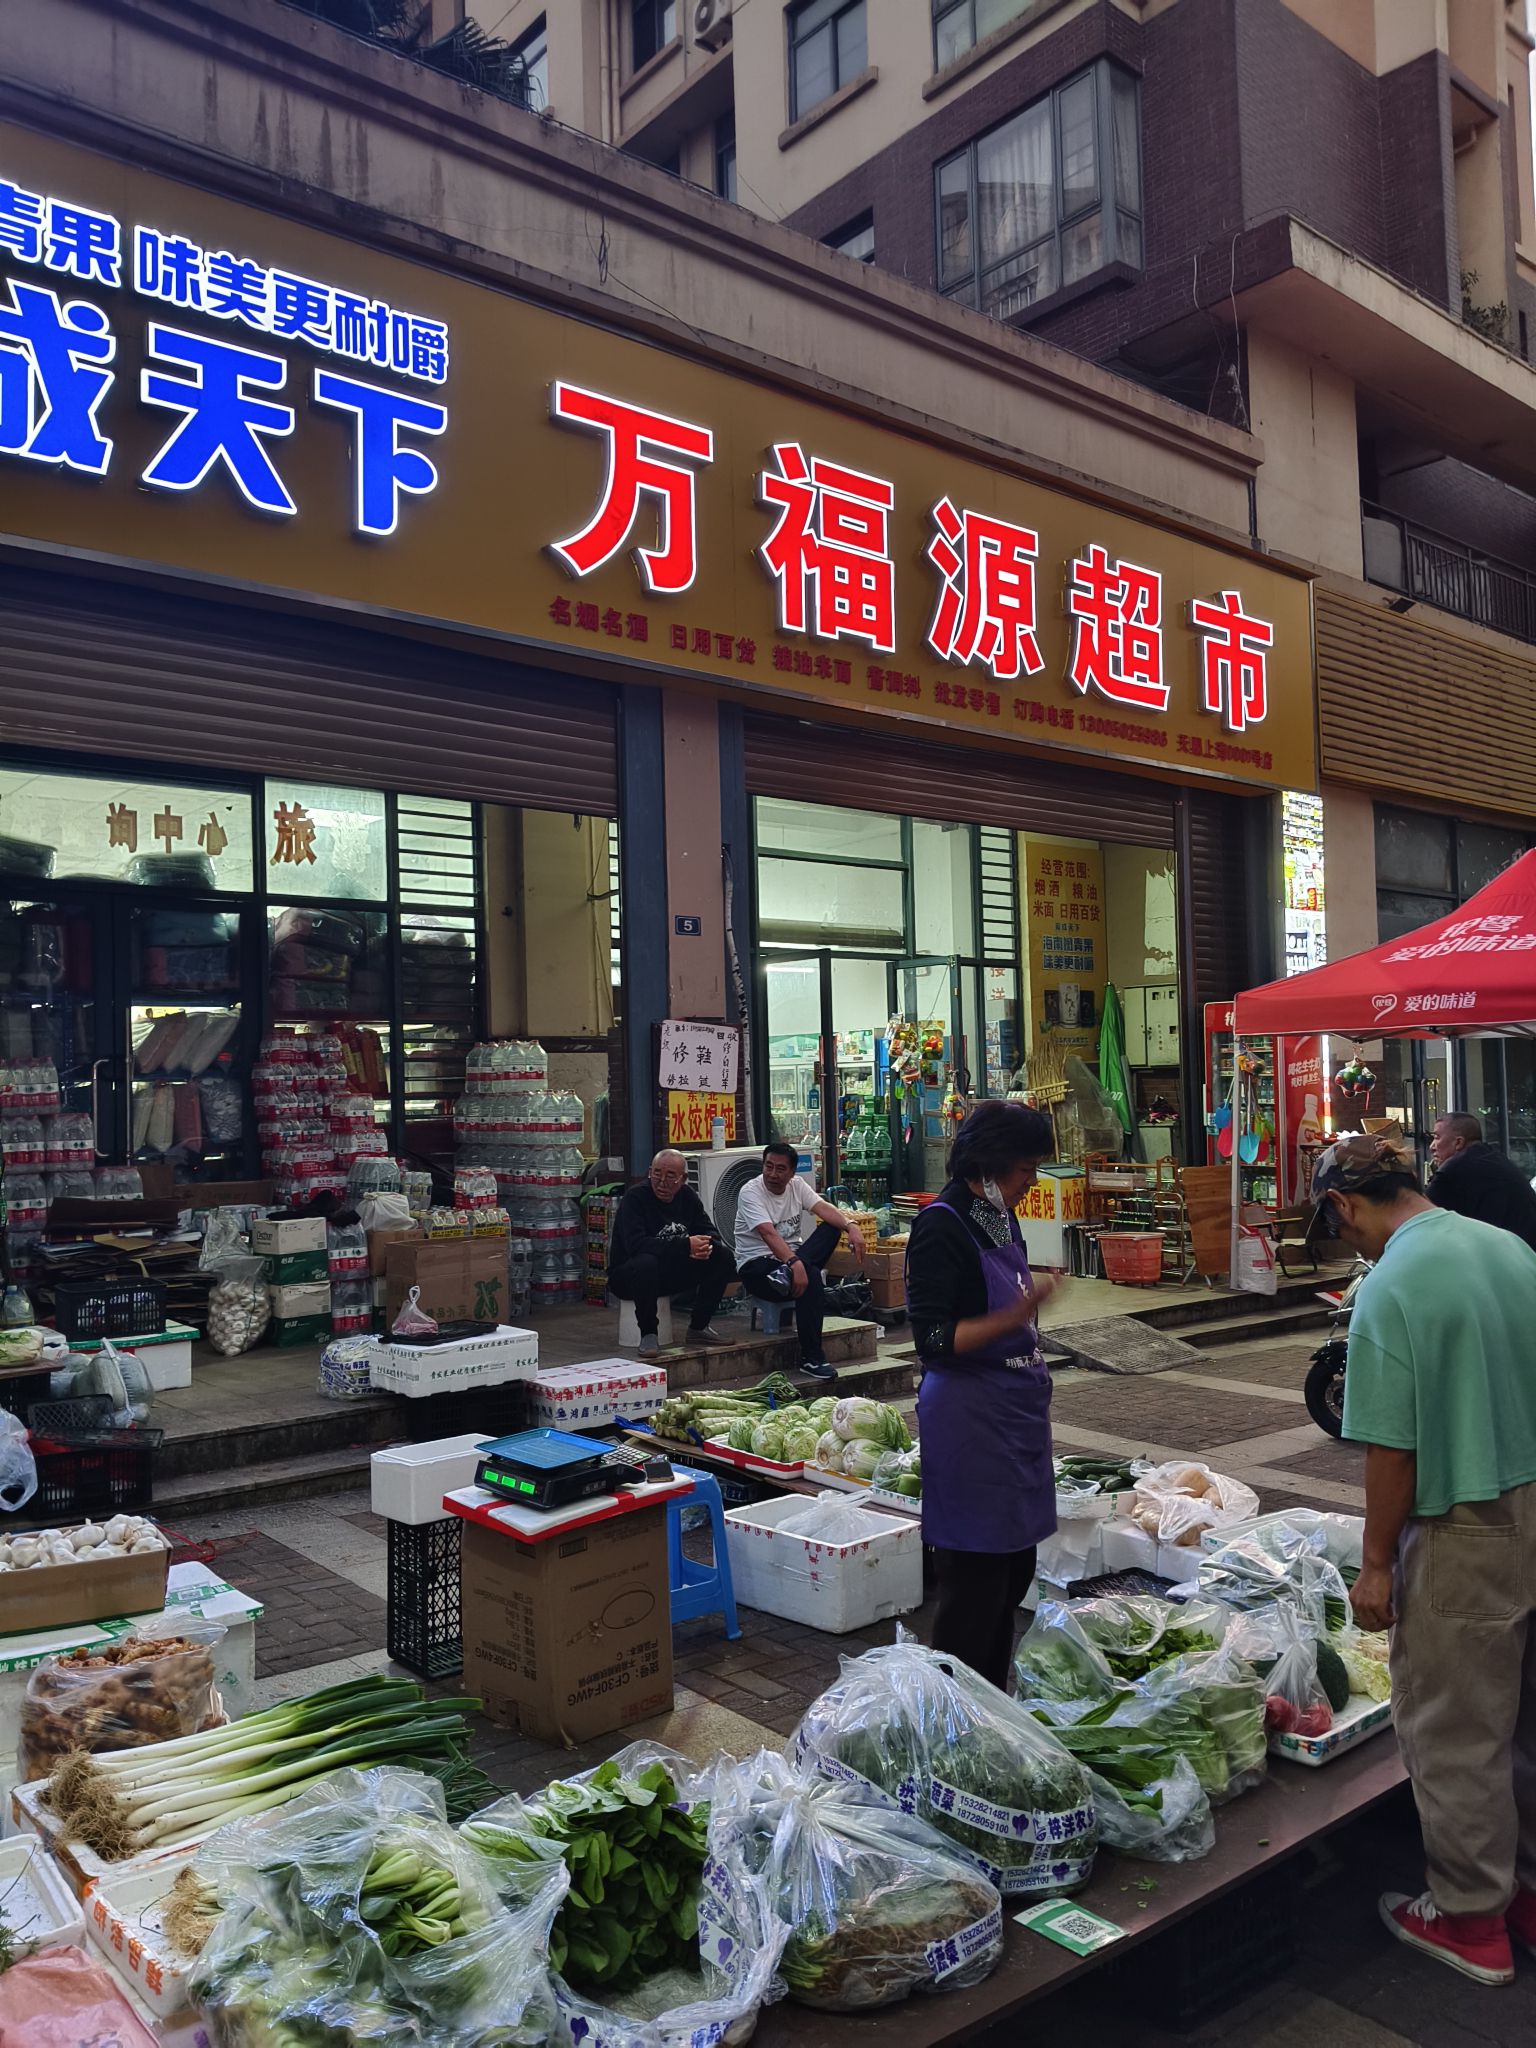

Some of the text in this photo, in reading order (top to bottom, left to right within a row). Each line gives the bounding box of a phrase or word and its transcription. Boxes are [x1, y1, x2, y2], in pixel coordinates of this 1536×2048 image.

[549, 380, 1276, 733] 万福源超市
[548, 595, 649, 642] 名烟名酒
[670, 623, 757, 665] 日用百货
[681, 918, 694, 933] 5
[1033, 901, 1101, 922] 米面 日用百货
[1380, 933, 1536, 964] 爱的味道
[1403, 992, 1477, 1013] 爱的味道
[672, 1042, 712, 1066] 修鞋
[475, 1646, 517, 1673] CF30F4WG
[567, 1671, 630, 1706] CF30F4WG
[931, 1779, 957, 1813] 蔬菜
[959, 1794, 1011, 1821] 15328214821
[956, 1806, 1010, 1836] 18728059100
